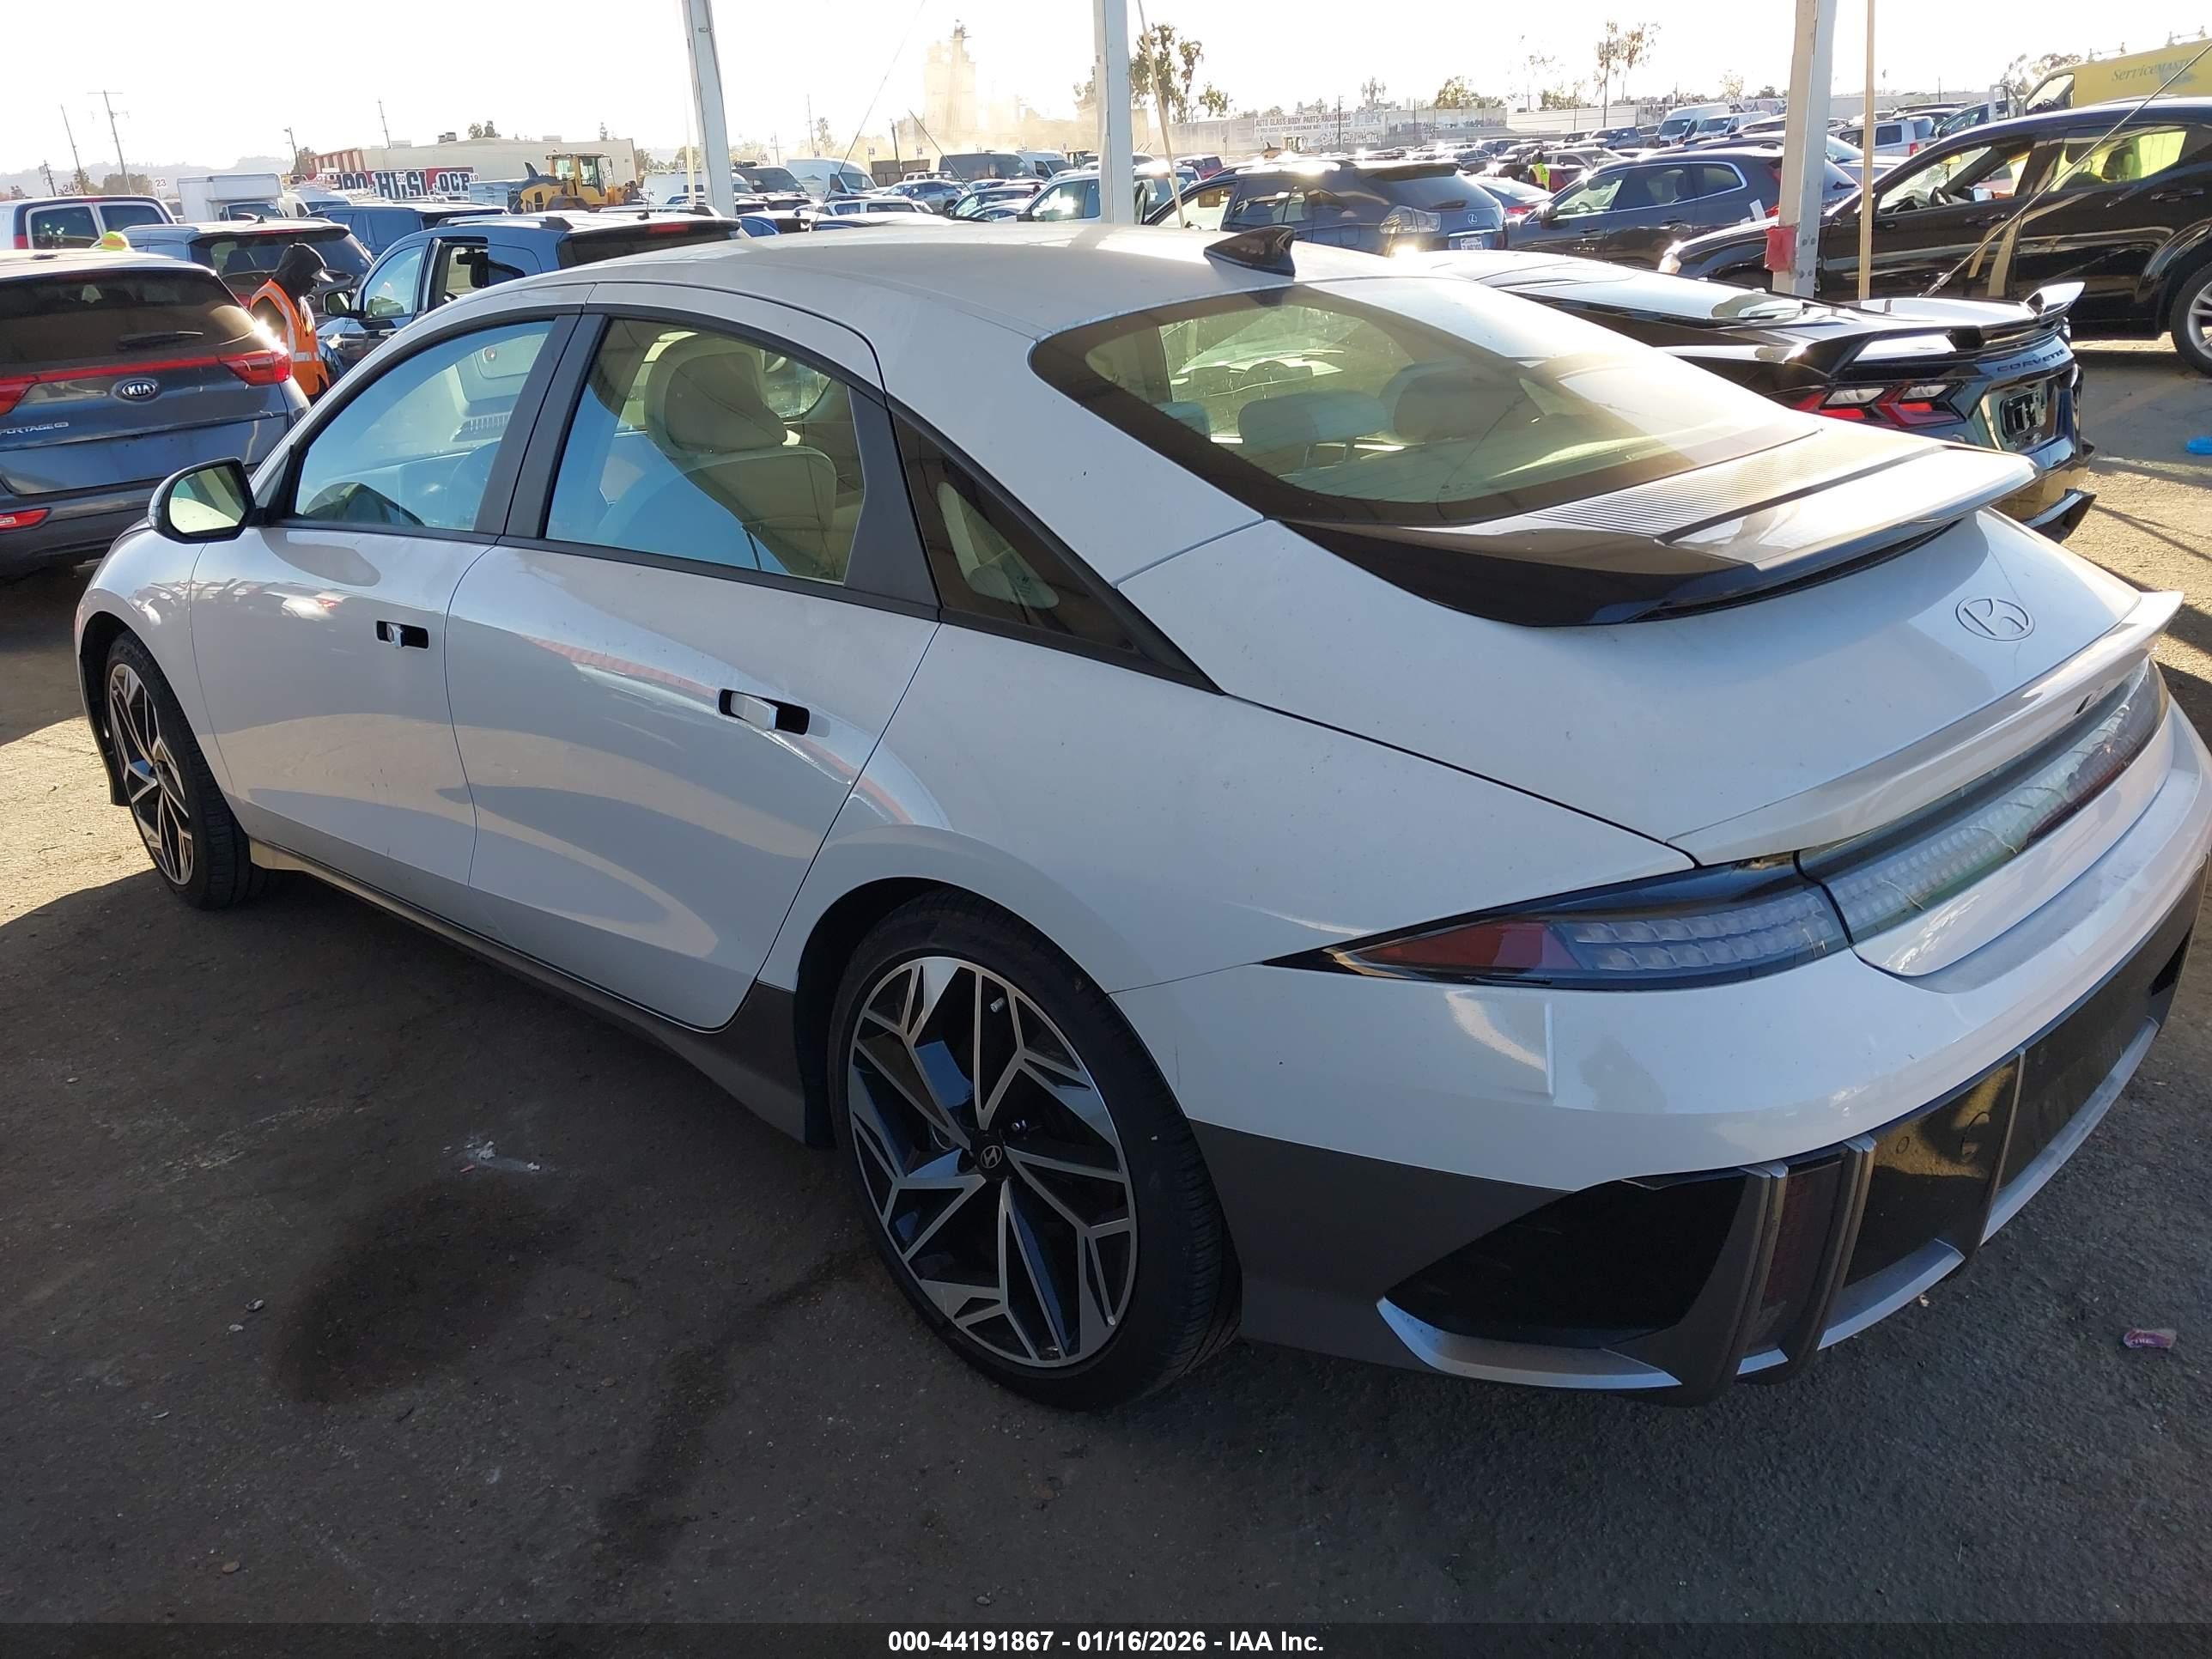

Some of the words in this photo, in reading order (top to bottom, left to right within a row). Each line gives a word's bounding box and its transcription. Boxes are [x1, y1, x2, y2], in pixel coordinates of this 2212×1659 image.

[2112, 58, 2197, 82] ServiceMAST
[1303, 113, 1351, 125] PARTS-RADIAORS
[155, 179, 167, 187] 23
[1996, 348, 2067, 372] CORVETTE
[127, 384, 151, 396] KIA
